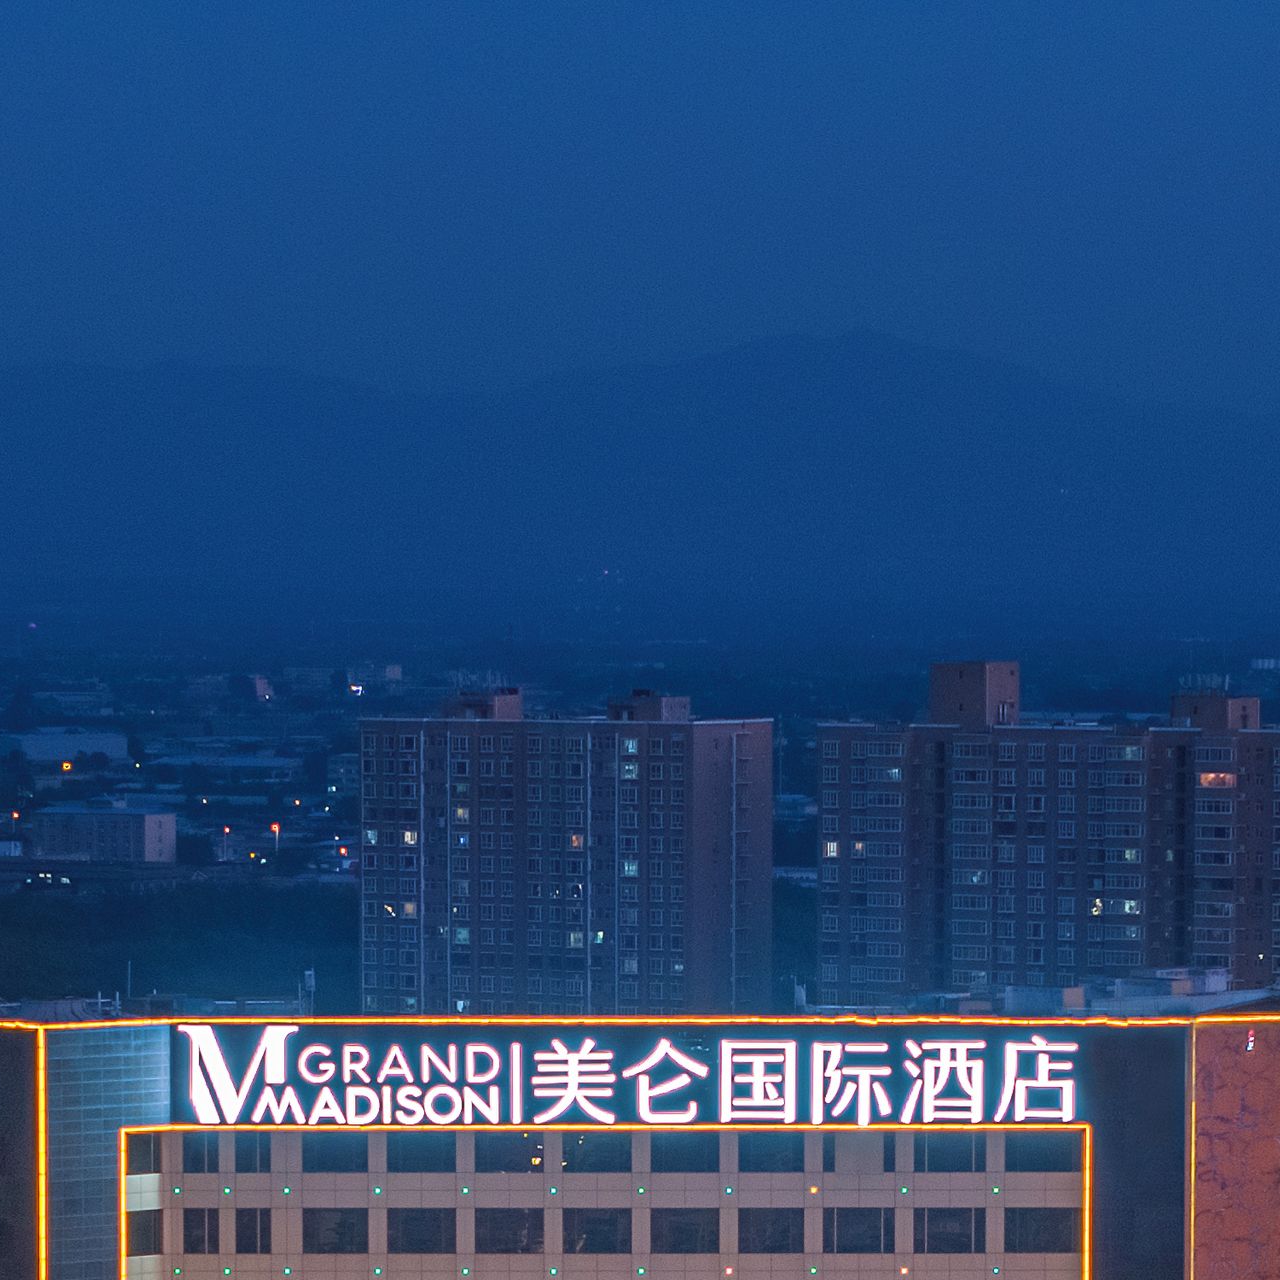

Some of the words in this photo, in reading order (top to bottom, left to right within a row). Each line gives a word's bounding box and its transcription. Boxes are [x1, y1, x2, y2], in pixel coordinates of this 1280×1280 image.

[297, 1043, 503, 1084] GRAND
[531, 1036, 1079, 1127] 美仑国际酒店
[251, 1085, 500, 1125] MADISON
